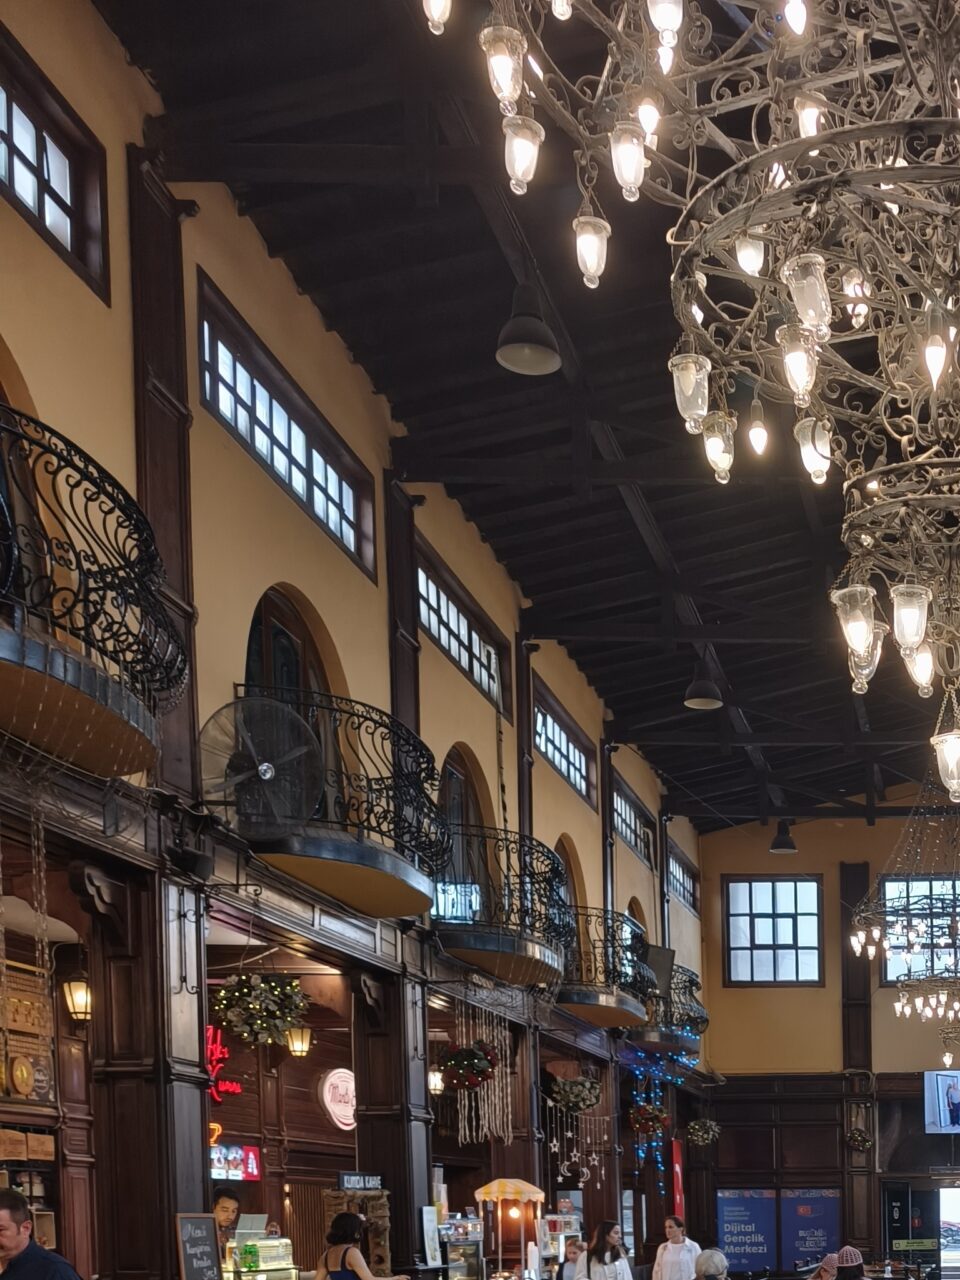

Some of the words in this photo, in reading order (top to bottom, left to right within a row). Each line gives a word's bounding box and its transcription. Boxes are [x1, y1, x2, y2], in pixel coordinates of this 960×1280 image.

[724, 1222, 755, 1234] Dijital
[724, 1233, 765, 1244] Gençlik
[724, 1244, 767, 1254] Merkezi
